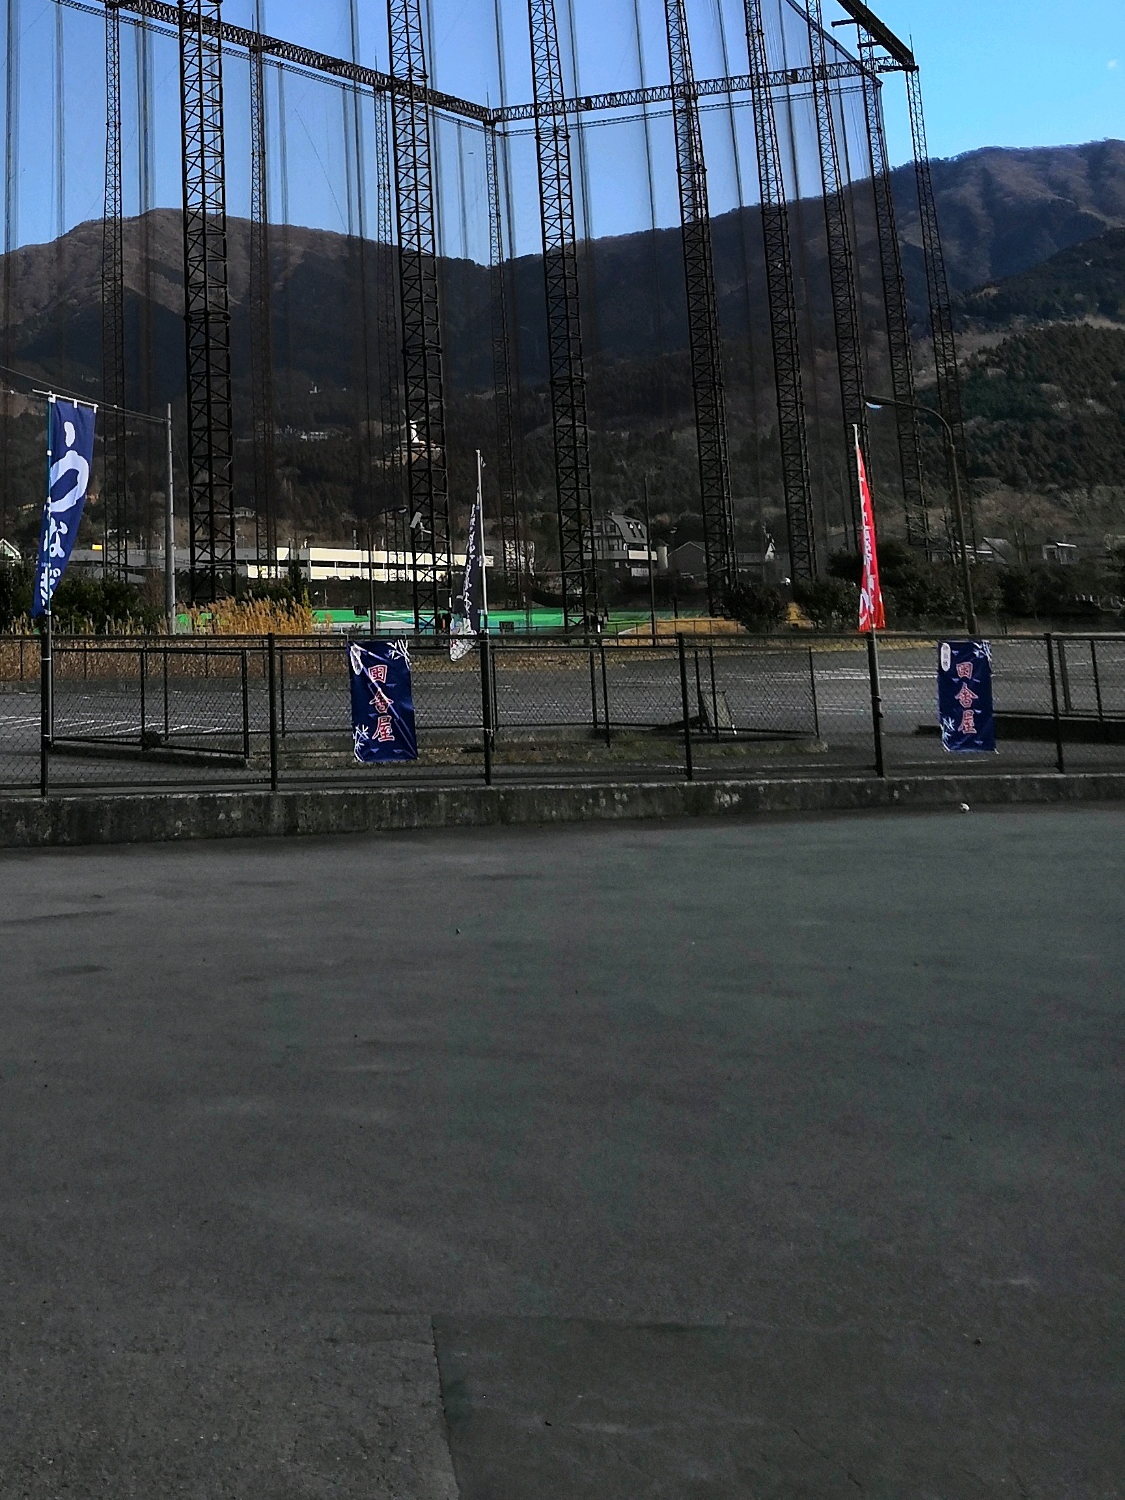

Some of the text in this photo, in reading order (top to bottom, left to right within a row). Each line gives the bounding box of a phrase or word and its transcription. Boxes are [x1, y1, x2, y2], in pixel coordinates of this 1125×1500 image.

[369, 664, 395, 742] 田舎屋
[955, 661, 979, 734] 田舎屋
